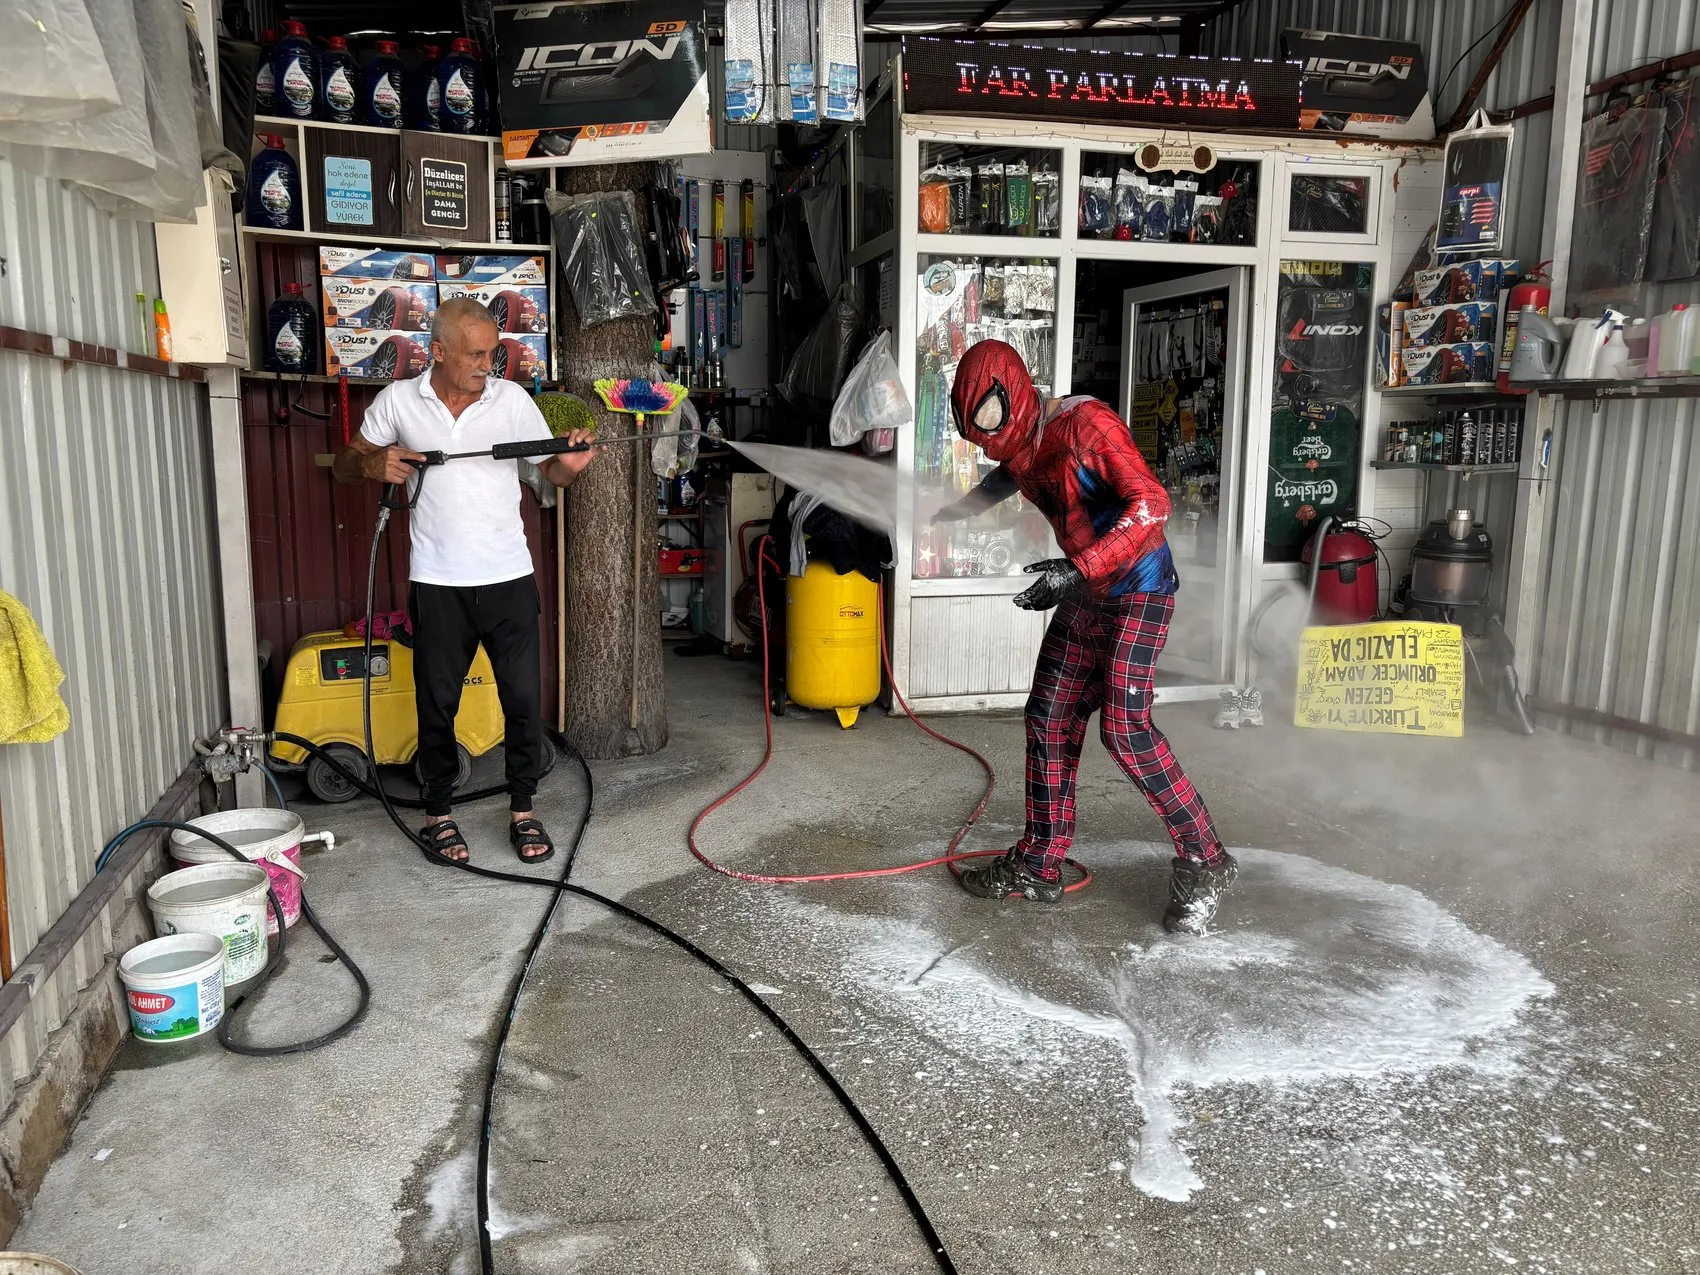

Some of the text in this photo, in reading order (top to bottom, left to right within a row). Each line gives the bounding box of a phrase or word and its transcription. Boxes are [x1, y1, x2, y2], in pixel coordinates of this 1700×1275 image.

[654, 23, 678, 33] 5D
[516, 37, 681, 71] ICON
[1304, 57, 1411, 80] ICON
[1046, 69, 1256, 110] PARLATMA
[339, 161, 357, 170] Seni
[328, 170, 369, 180] hak edene
[424, 167, 465, 182] Düzelicez
[434, 200, 457, 209] DAHA
[336, 211, 364, 222] YÜREK
[431, 209, 461, 219] GENCİZ
[341, 286, 366, 295] Dust
[342, 335, 368, 345] Dust
[1293, 444, 1332, 459] Carlsberg
[1274, 479, 1338, 504] Carlsberg
[1325, 666, 1366, 682] ADAM
[1345, 687, 1394, 705] GEZEN
[138, 997, 166, 1009] AHMET
